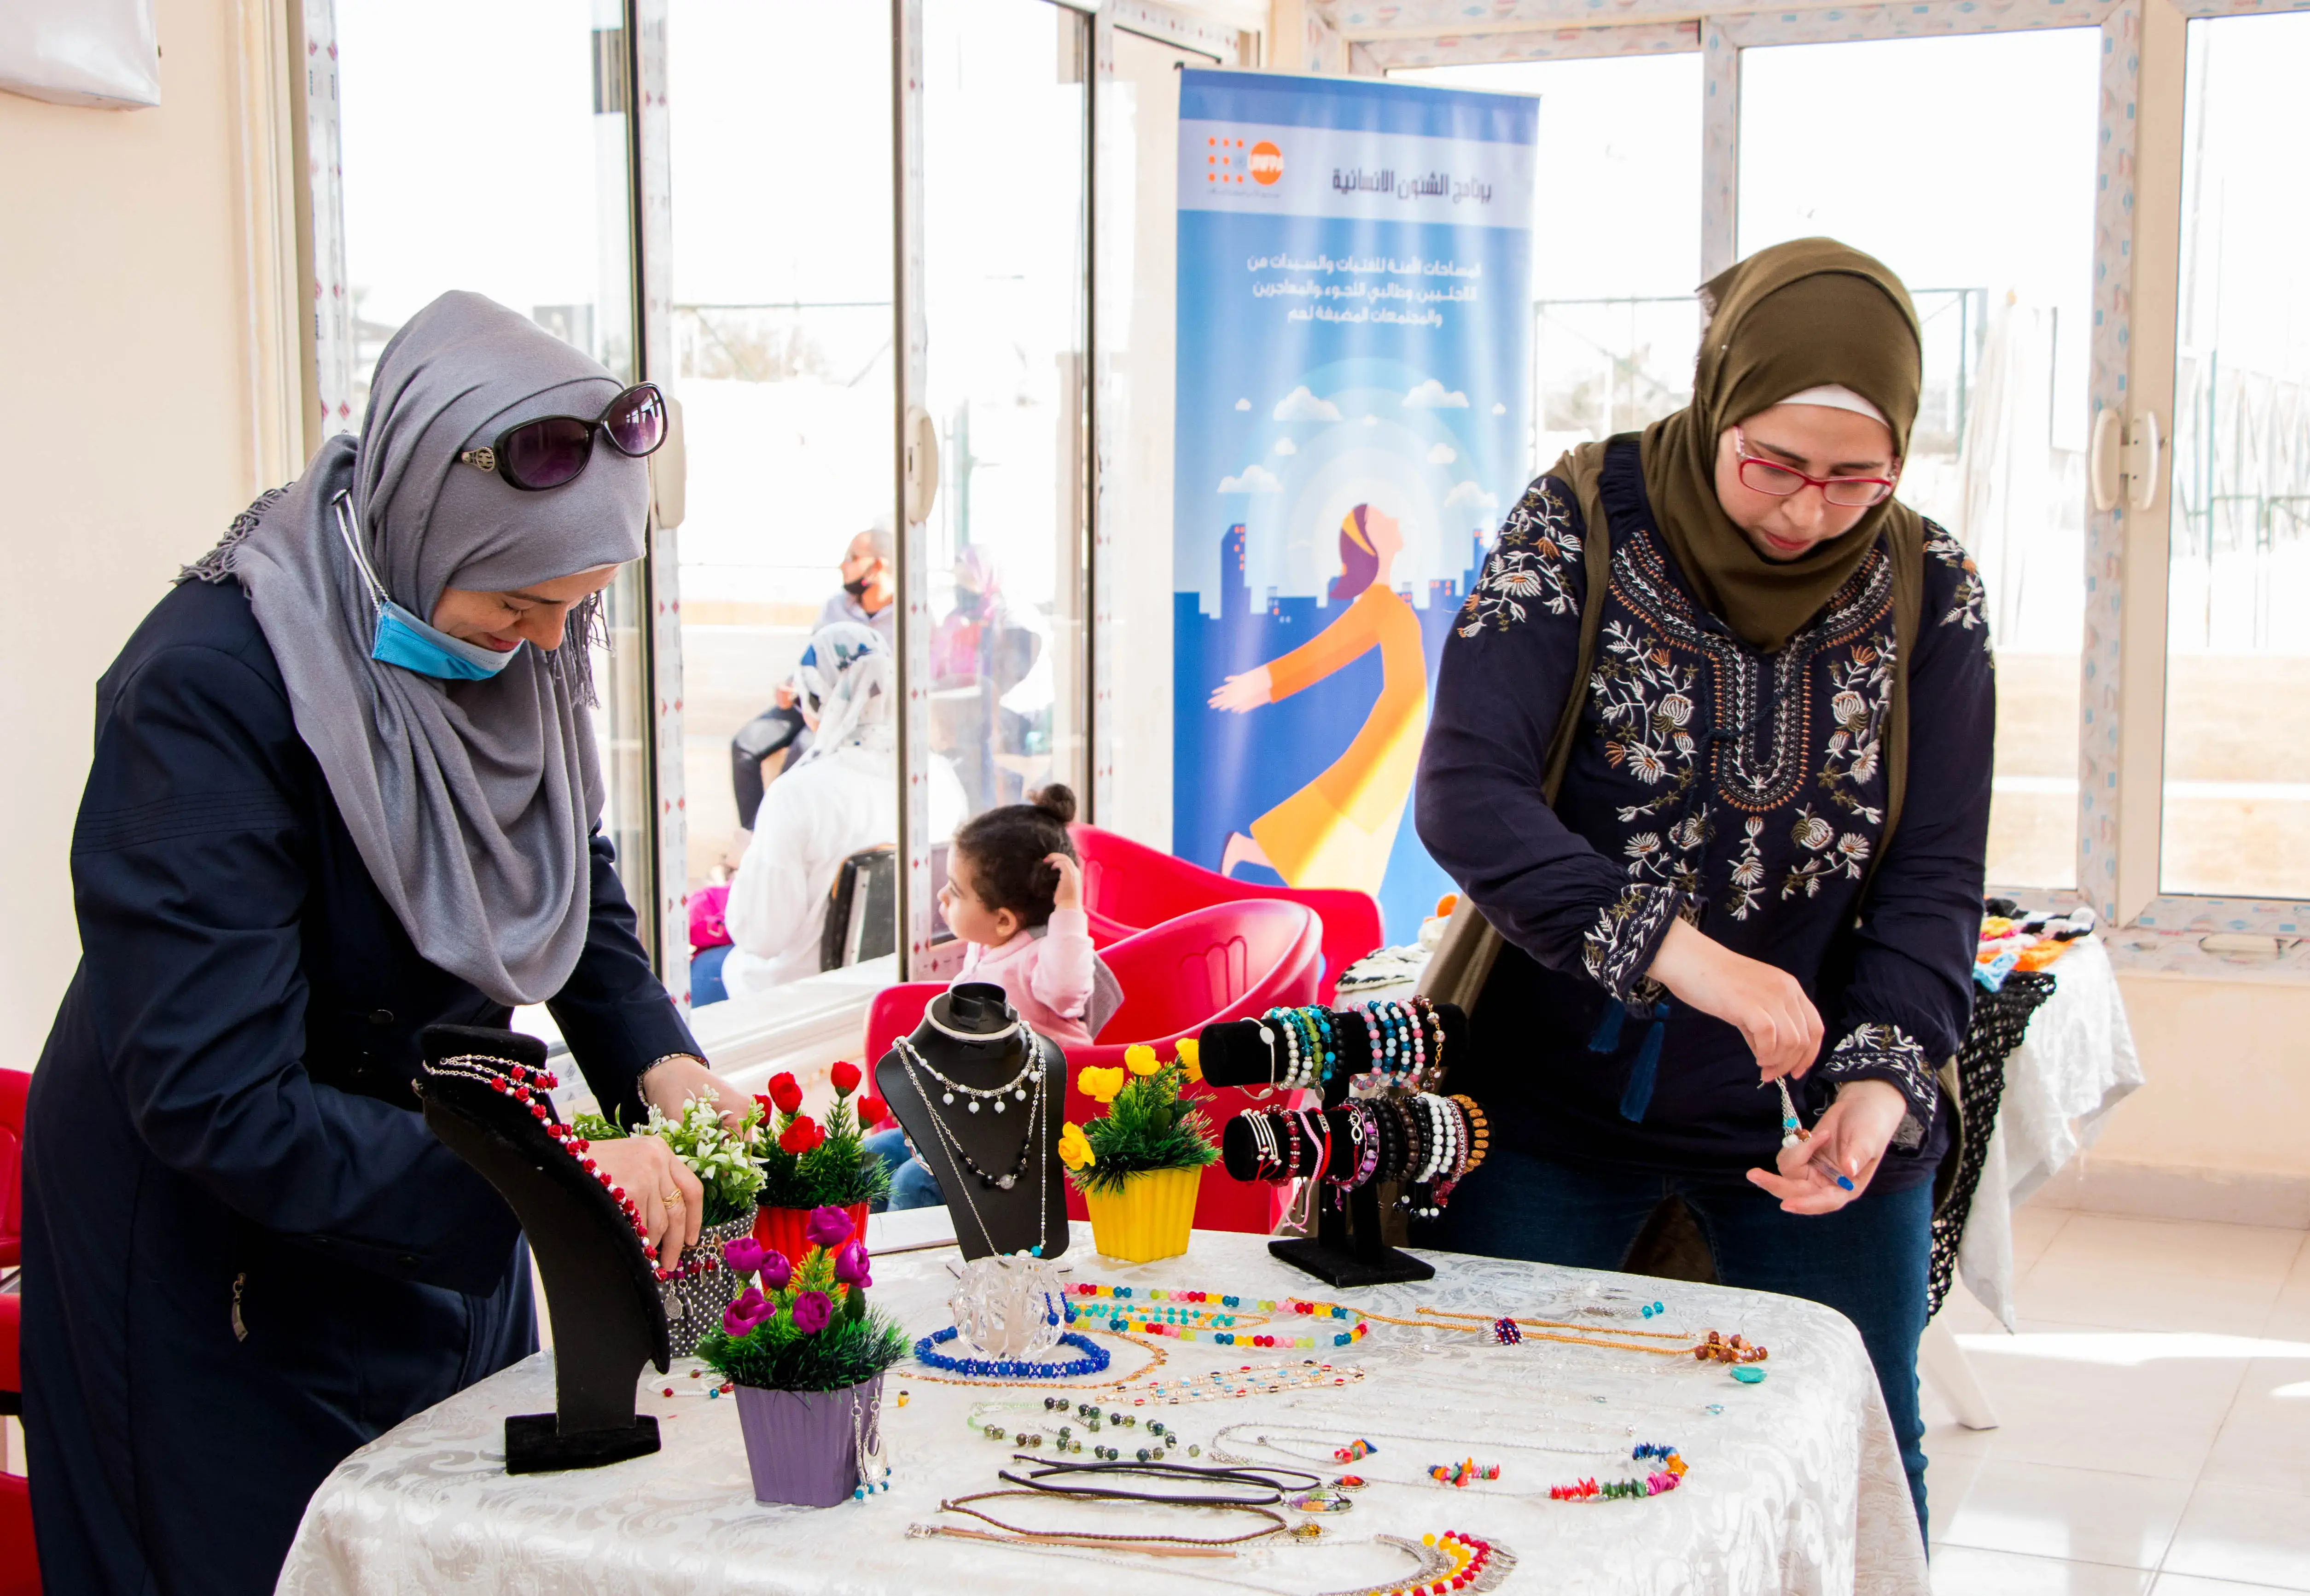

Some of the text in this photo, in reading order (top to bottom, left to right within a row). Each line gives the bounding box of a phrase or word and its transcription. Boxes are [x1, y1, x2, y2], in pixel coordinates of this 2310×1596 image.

[1452, 175, 1492, 204] برنامج
[1247, 255, 1268, 272] من
[1269, 253, 1334, 275] والسيدات
[1252, 279, 1324, 299] والمهاجرين
[1325, 282, 1366, 300] اللجوء
[1288, 304, 1443, 328] والمجتمعات المضيفة لهم
